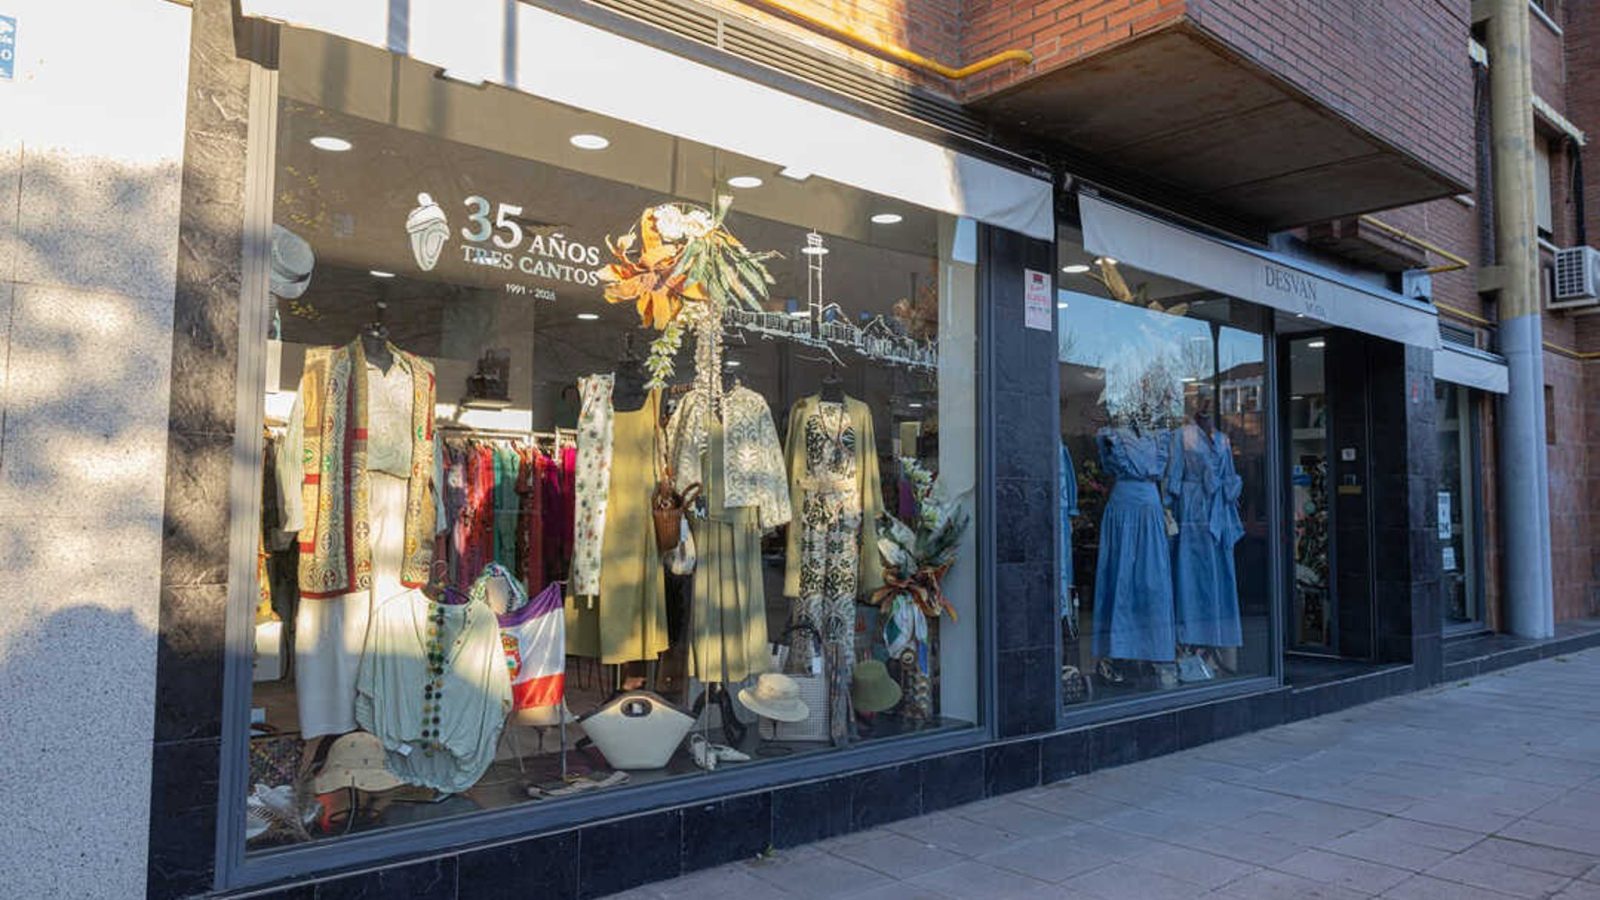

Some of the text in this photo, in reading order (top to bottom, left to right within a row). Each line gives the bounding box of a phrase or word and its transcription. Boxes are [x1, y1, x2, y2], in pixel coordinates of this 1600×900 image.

[461, 195, 600, 266] 35 AÑOS
[460, 245, 599, 286] TRES CANTOS
[1265, 265, 1317, 301] DESVAN
